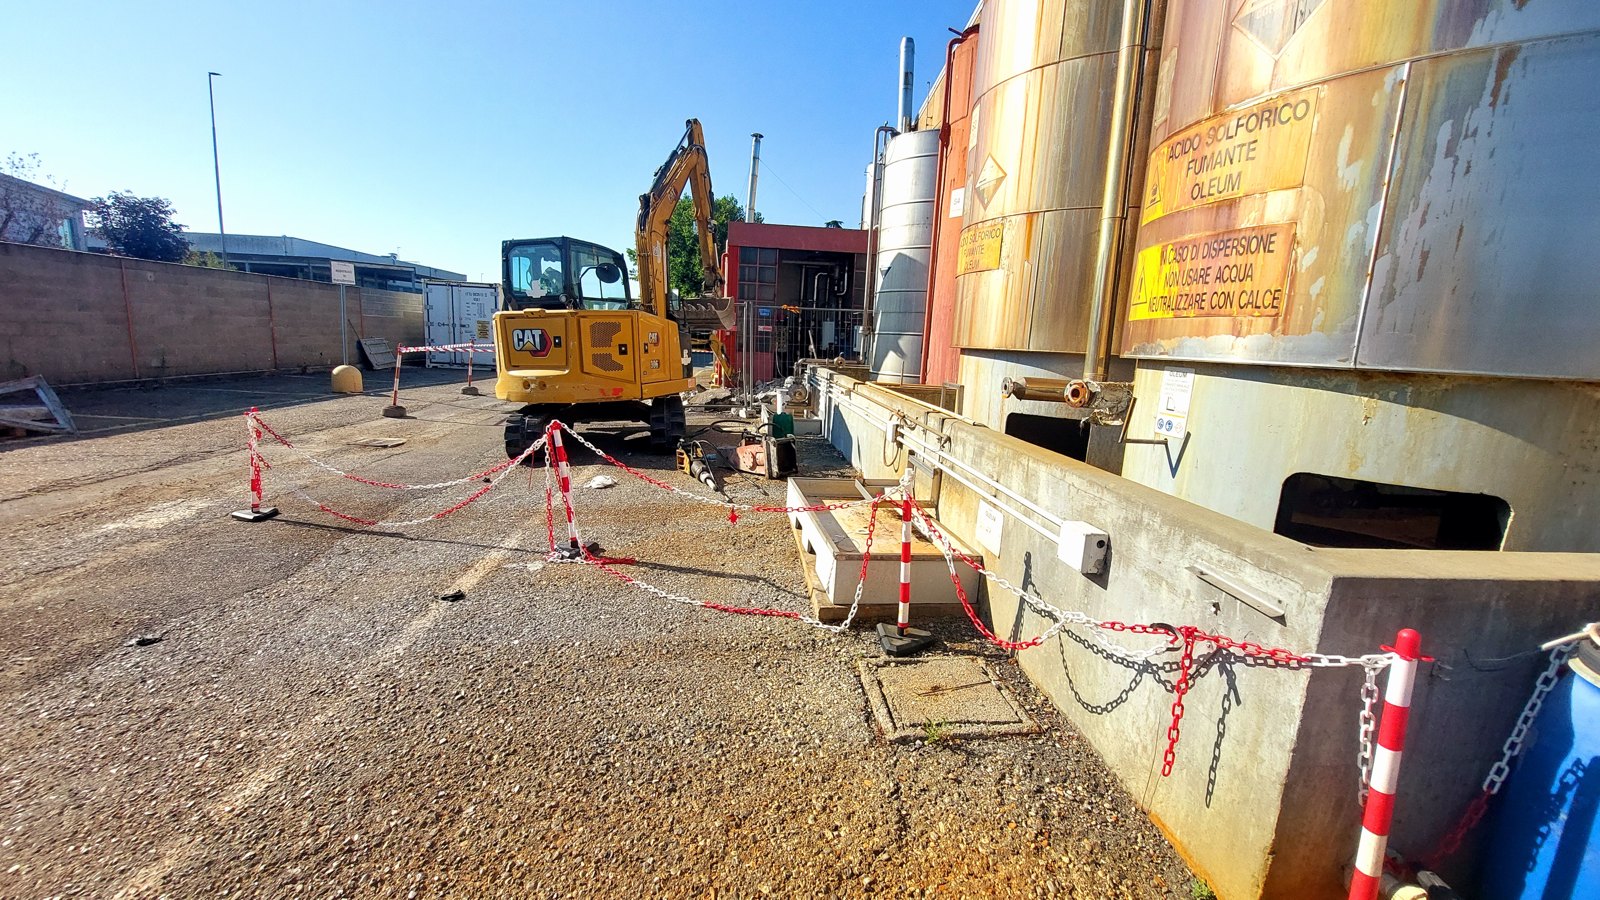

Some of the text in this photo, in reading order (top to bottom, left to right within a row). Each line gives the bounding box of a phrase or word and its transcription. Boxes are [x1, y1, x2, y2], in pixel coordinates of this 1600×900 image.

[1168, 100, 1310, 163] ACIDO SOLFORICO
[1186, 140, 1258, 178] FUMANTE
[1191, 171, 1243, 201] OLEUM
[1168, 245, 1188, 265] CASO
[1190, 244, 1199, 261] DI
[1202, 232, 1277, 260] DISPERSIONE
[1164, 263, 1253, 288] NON USARE ACQUA
[1148, 289, 1281, 312] NEUTRALIZZARE CON CALCE
[513, 329, 542, 351] CAT
[648, 332, 658, 344] CAT
